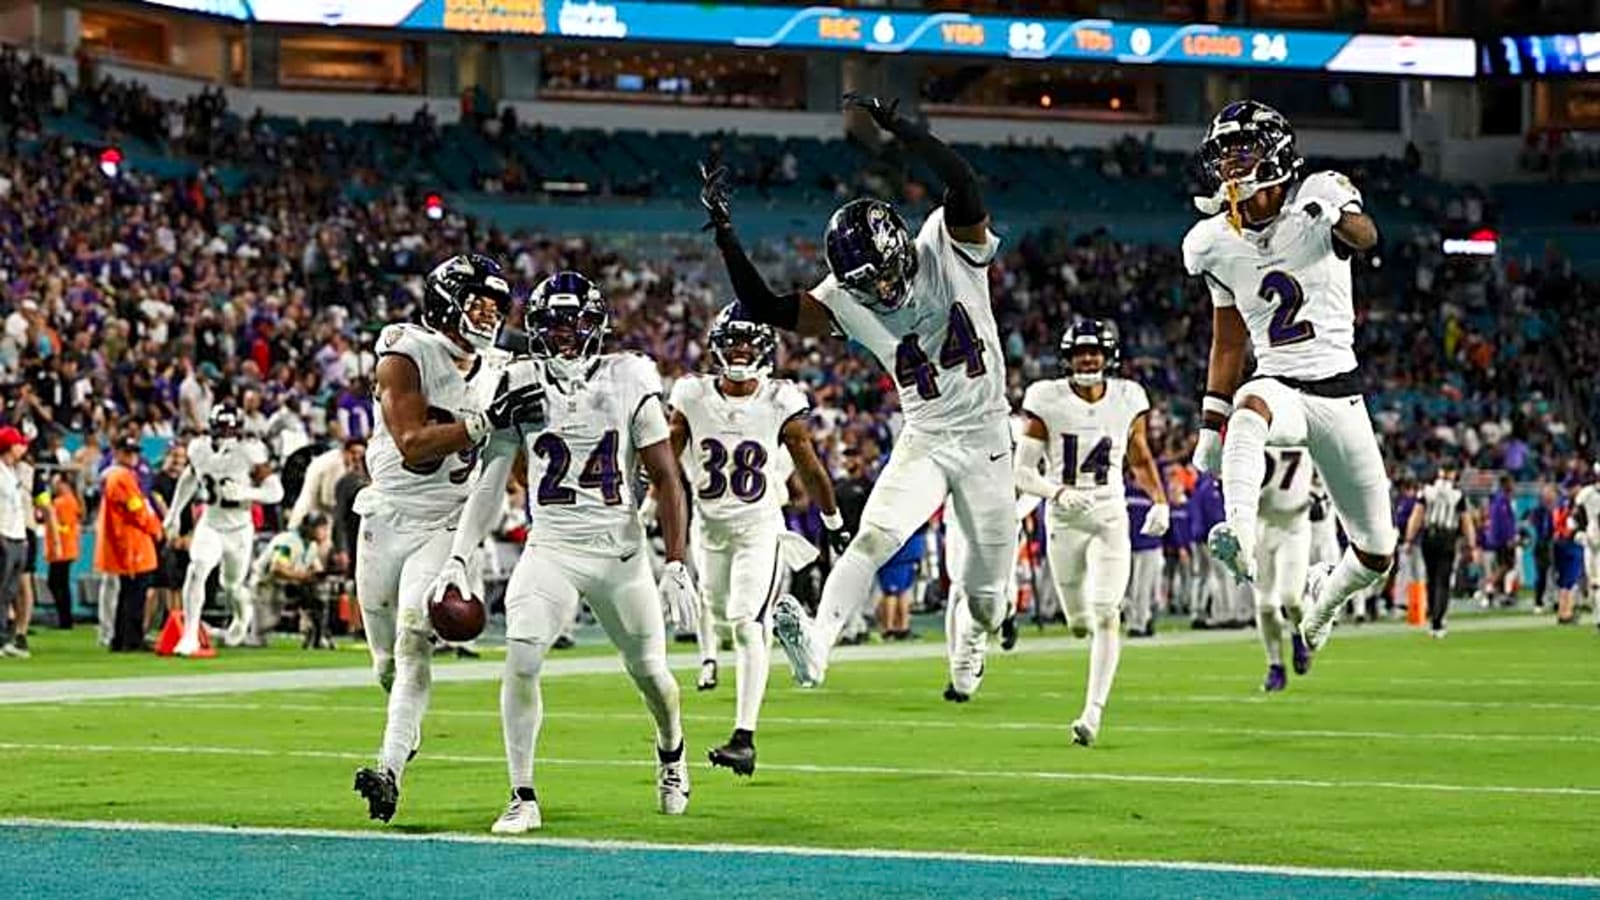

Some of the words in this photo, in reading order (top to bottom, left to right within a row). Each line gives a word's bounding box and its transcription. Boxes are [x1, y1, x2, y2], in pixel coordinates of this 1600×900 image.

[873, 15, 895, 43] 6
[941, 22, 984, 45] YDS
[1130, 27, 1151, 56] 0
[1183, 34, 1242, 56] LONG
[1252, 33, 1287, 61] 24
[1258, 270, 1316, 347] 2
[895, 302, 986, 400] 44
[532, 429, 623, 506] 24
[698, 437, 768, 502] 38
[1061, 433, 1112, 486] 14
